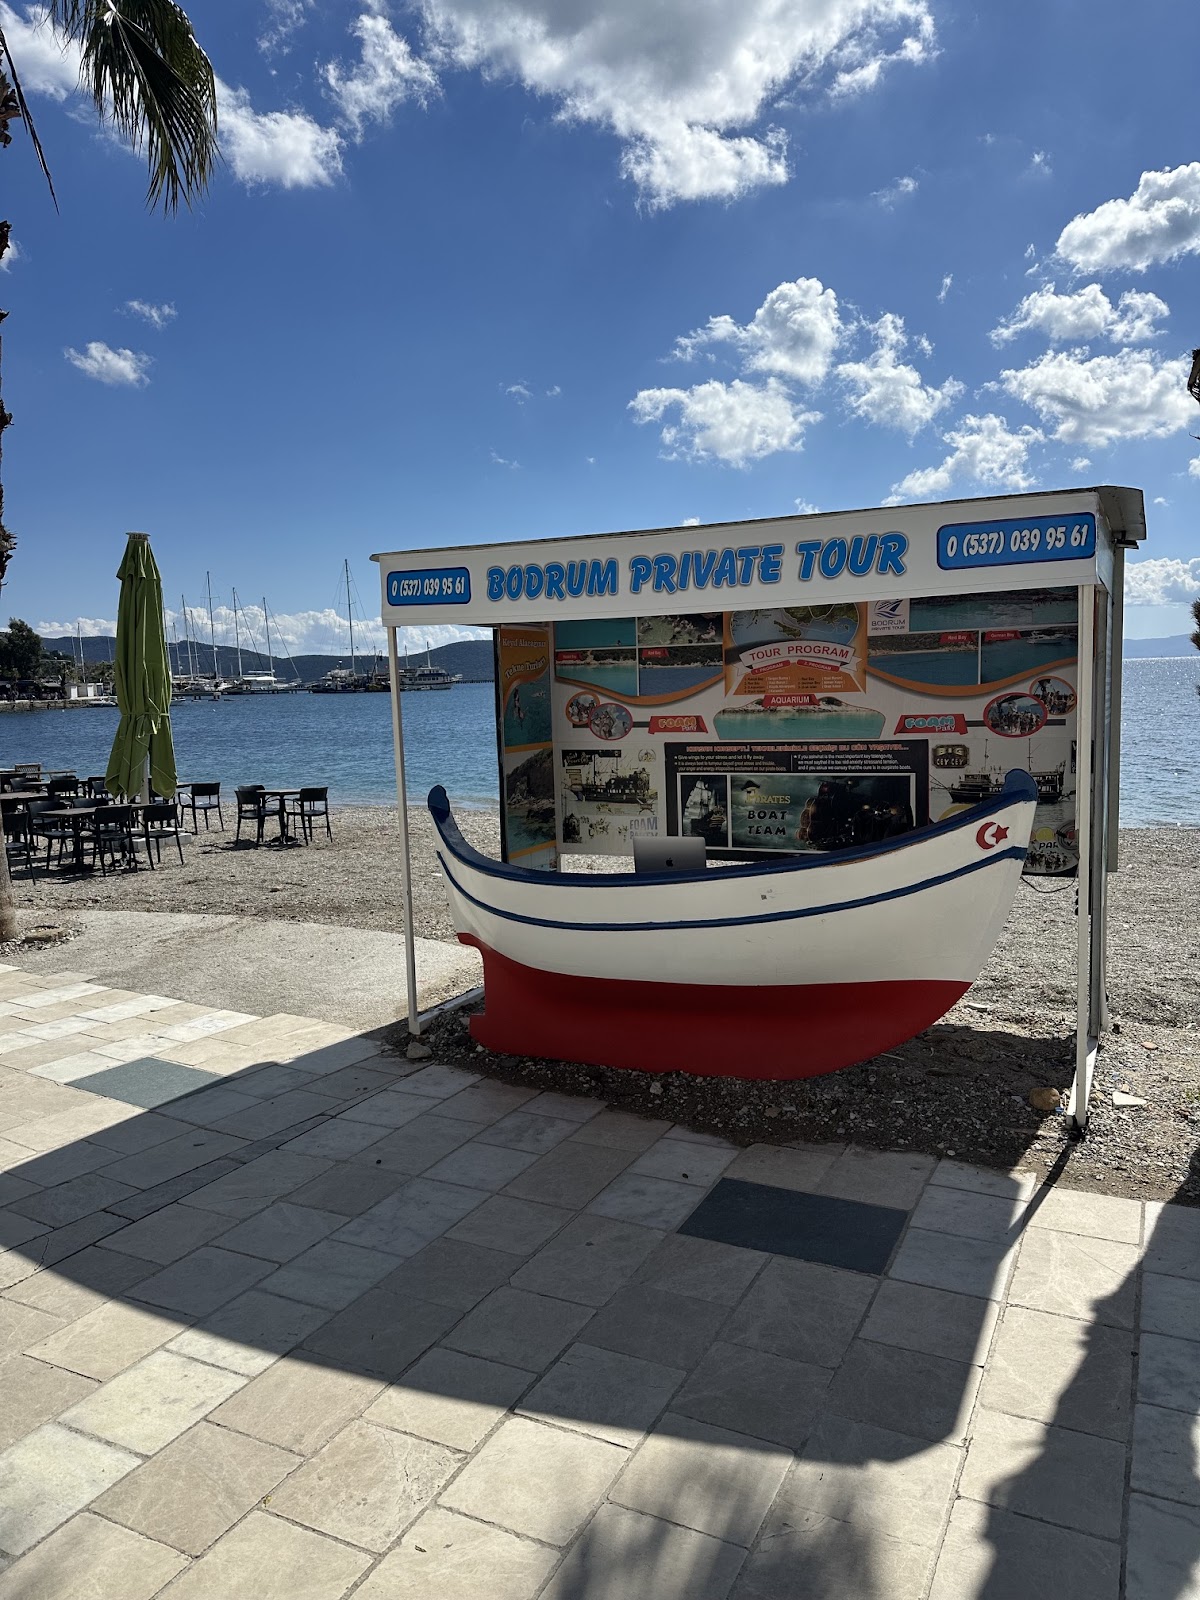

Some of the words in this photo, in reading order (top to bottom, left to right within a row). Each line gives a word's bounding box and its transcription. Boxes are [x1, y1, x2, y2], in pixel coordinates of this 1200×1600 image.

[945, 536, 957, 557] 0
[963, 531, 1004, 557] (537)
[1010, 529, 1041, 552] 039
[1046, 526, 1066, 551] 95
[1070, 524, 1088, 547] 61
[486, 558, 619, 602] BODRUM
[629, 543, 784, 595] PRIVATE
[796, 531, 908, 580] TOUR
[391, 580, 398, 597] 0
[400, 578, 421, 597] (537)
[423, 577, 440, 596] 039
[441, 577, 453, 596] 95
[454, 576, 465, 594] 61
[871, 619, 905, 627] BODRUM
[749, 648, 781, 661] TOUR
[787, 645, 849, 659] PROGRAM
[760, 662, 783, 673] PROGRAM
[809, 662, 832, 671] PROGRAM
[770, 696, 810, 704] AQUARIUM
[658, 716, 697, 729] FOAM
[905, 716, 955, 728] FOAM
[936, 747, 964, 756] BIG
[747, 810, 787, 821] BOAT
[629, 816, 658, 831] FOAM
[747, 825, 787, 836] TEAM
